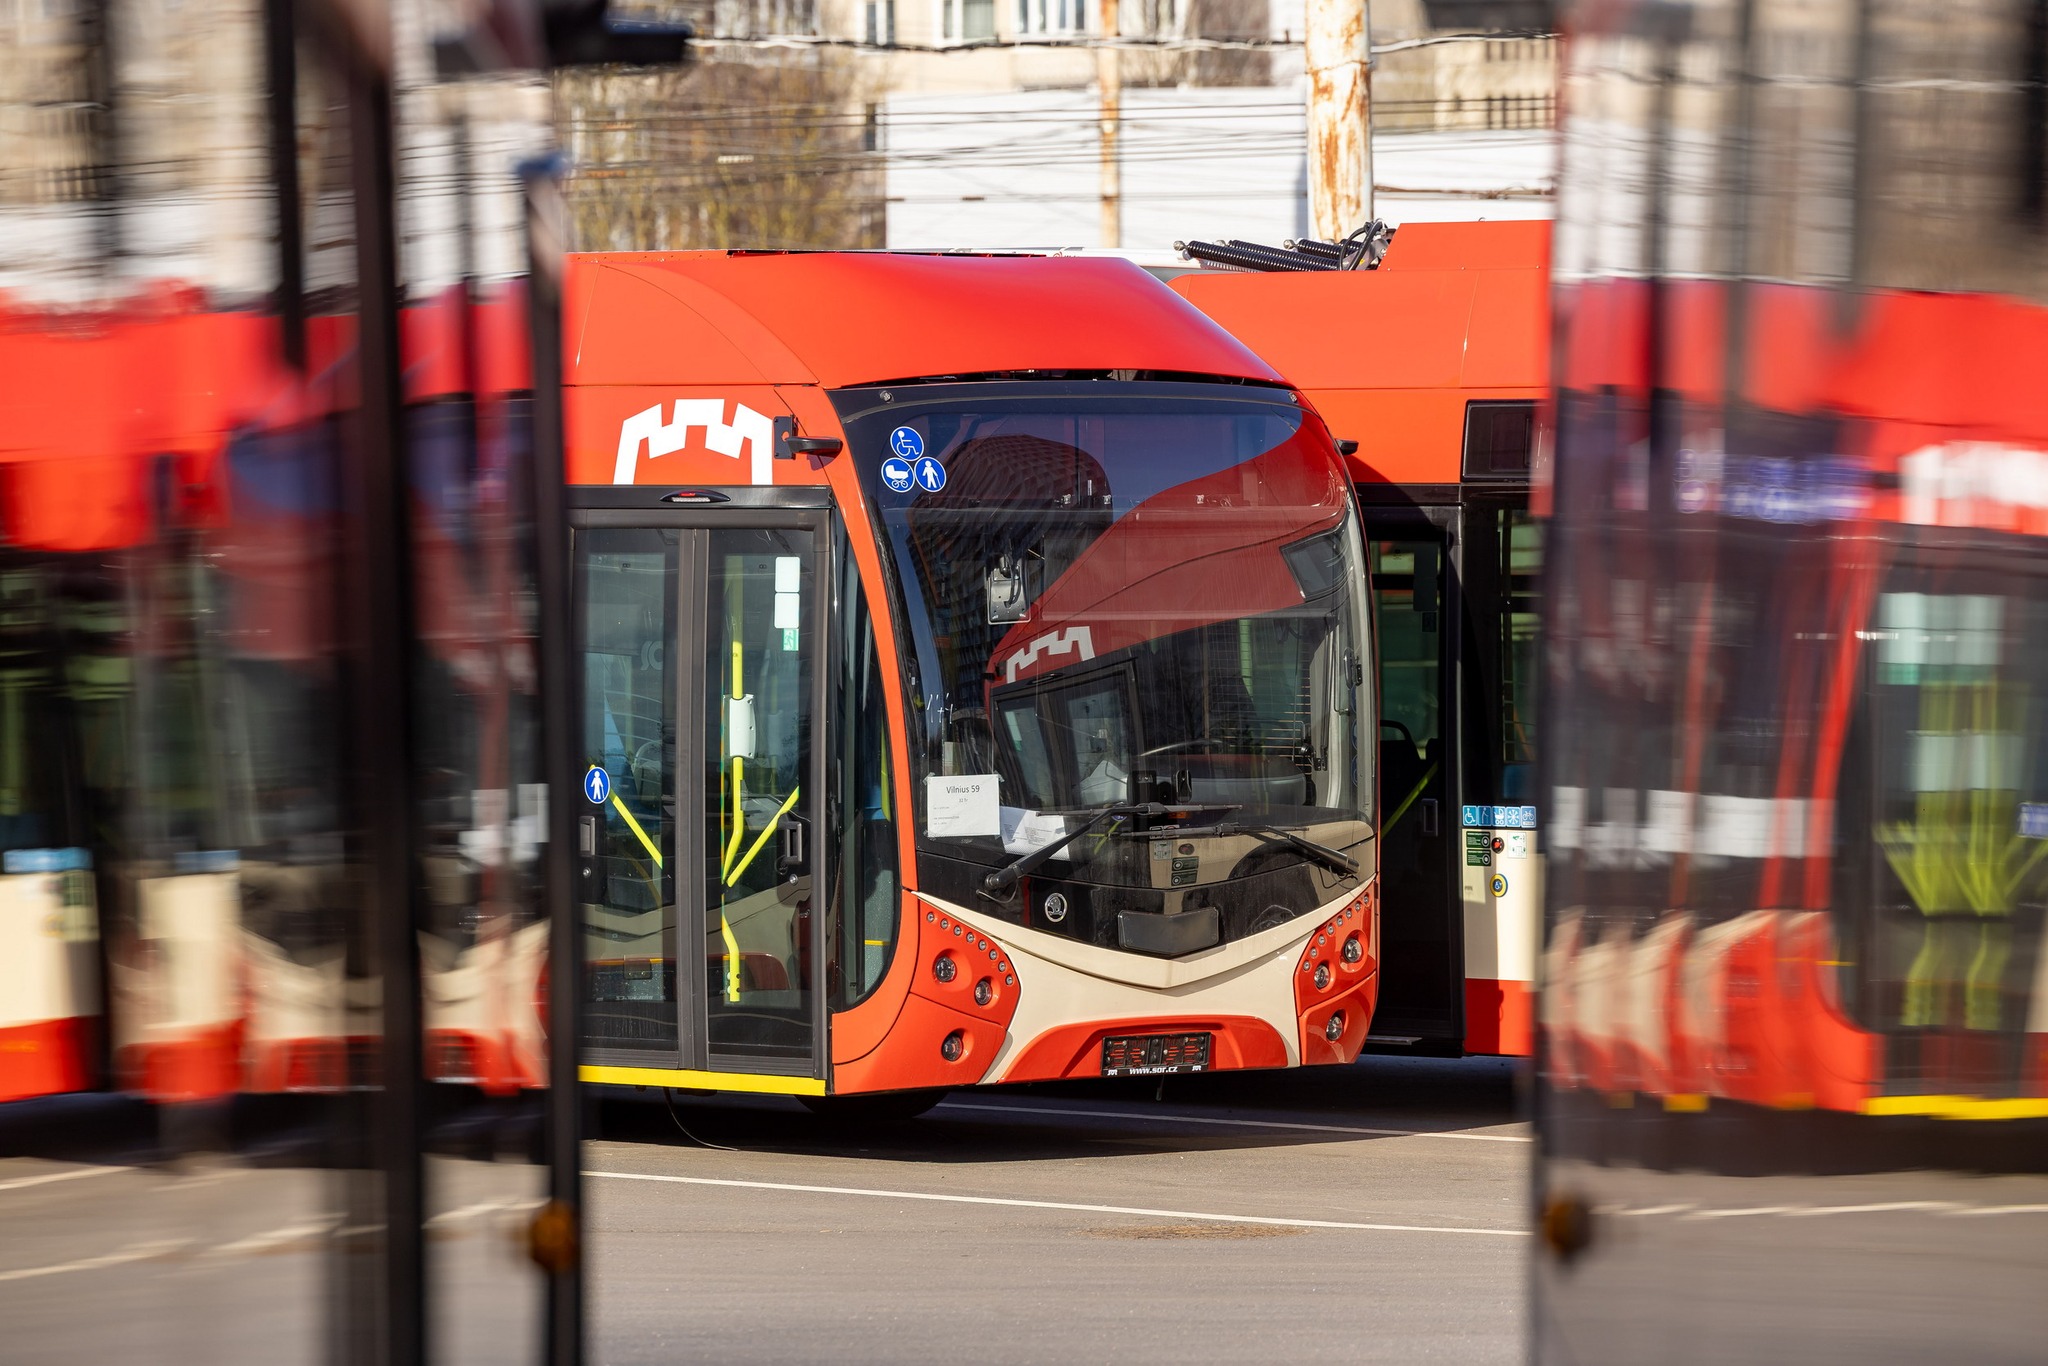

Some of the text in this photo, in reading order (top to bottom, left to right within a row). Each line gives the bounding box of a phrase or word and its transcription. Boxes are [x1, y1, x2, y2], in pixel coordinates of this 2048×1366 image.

[946, 784, 980, 794] Vilnius 59
[1129, 1066, 1178, 1074] www.sor.cz
